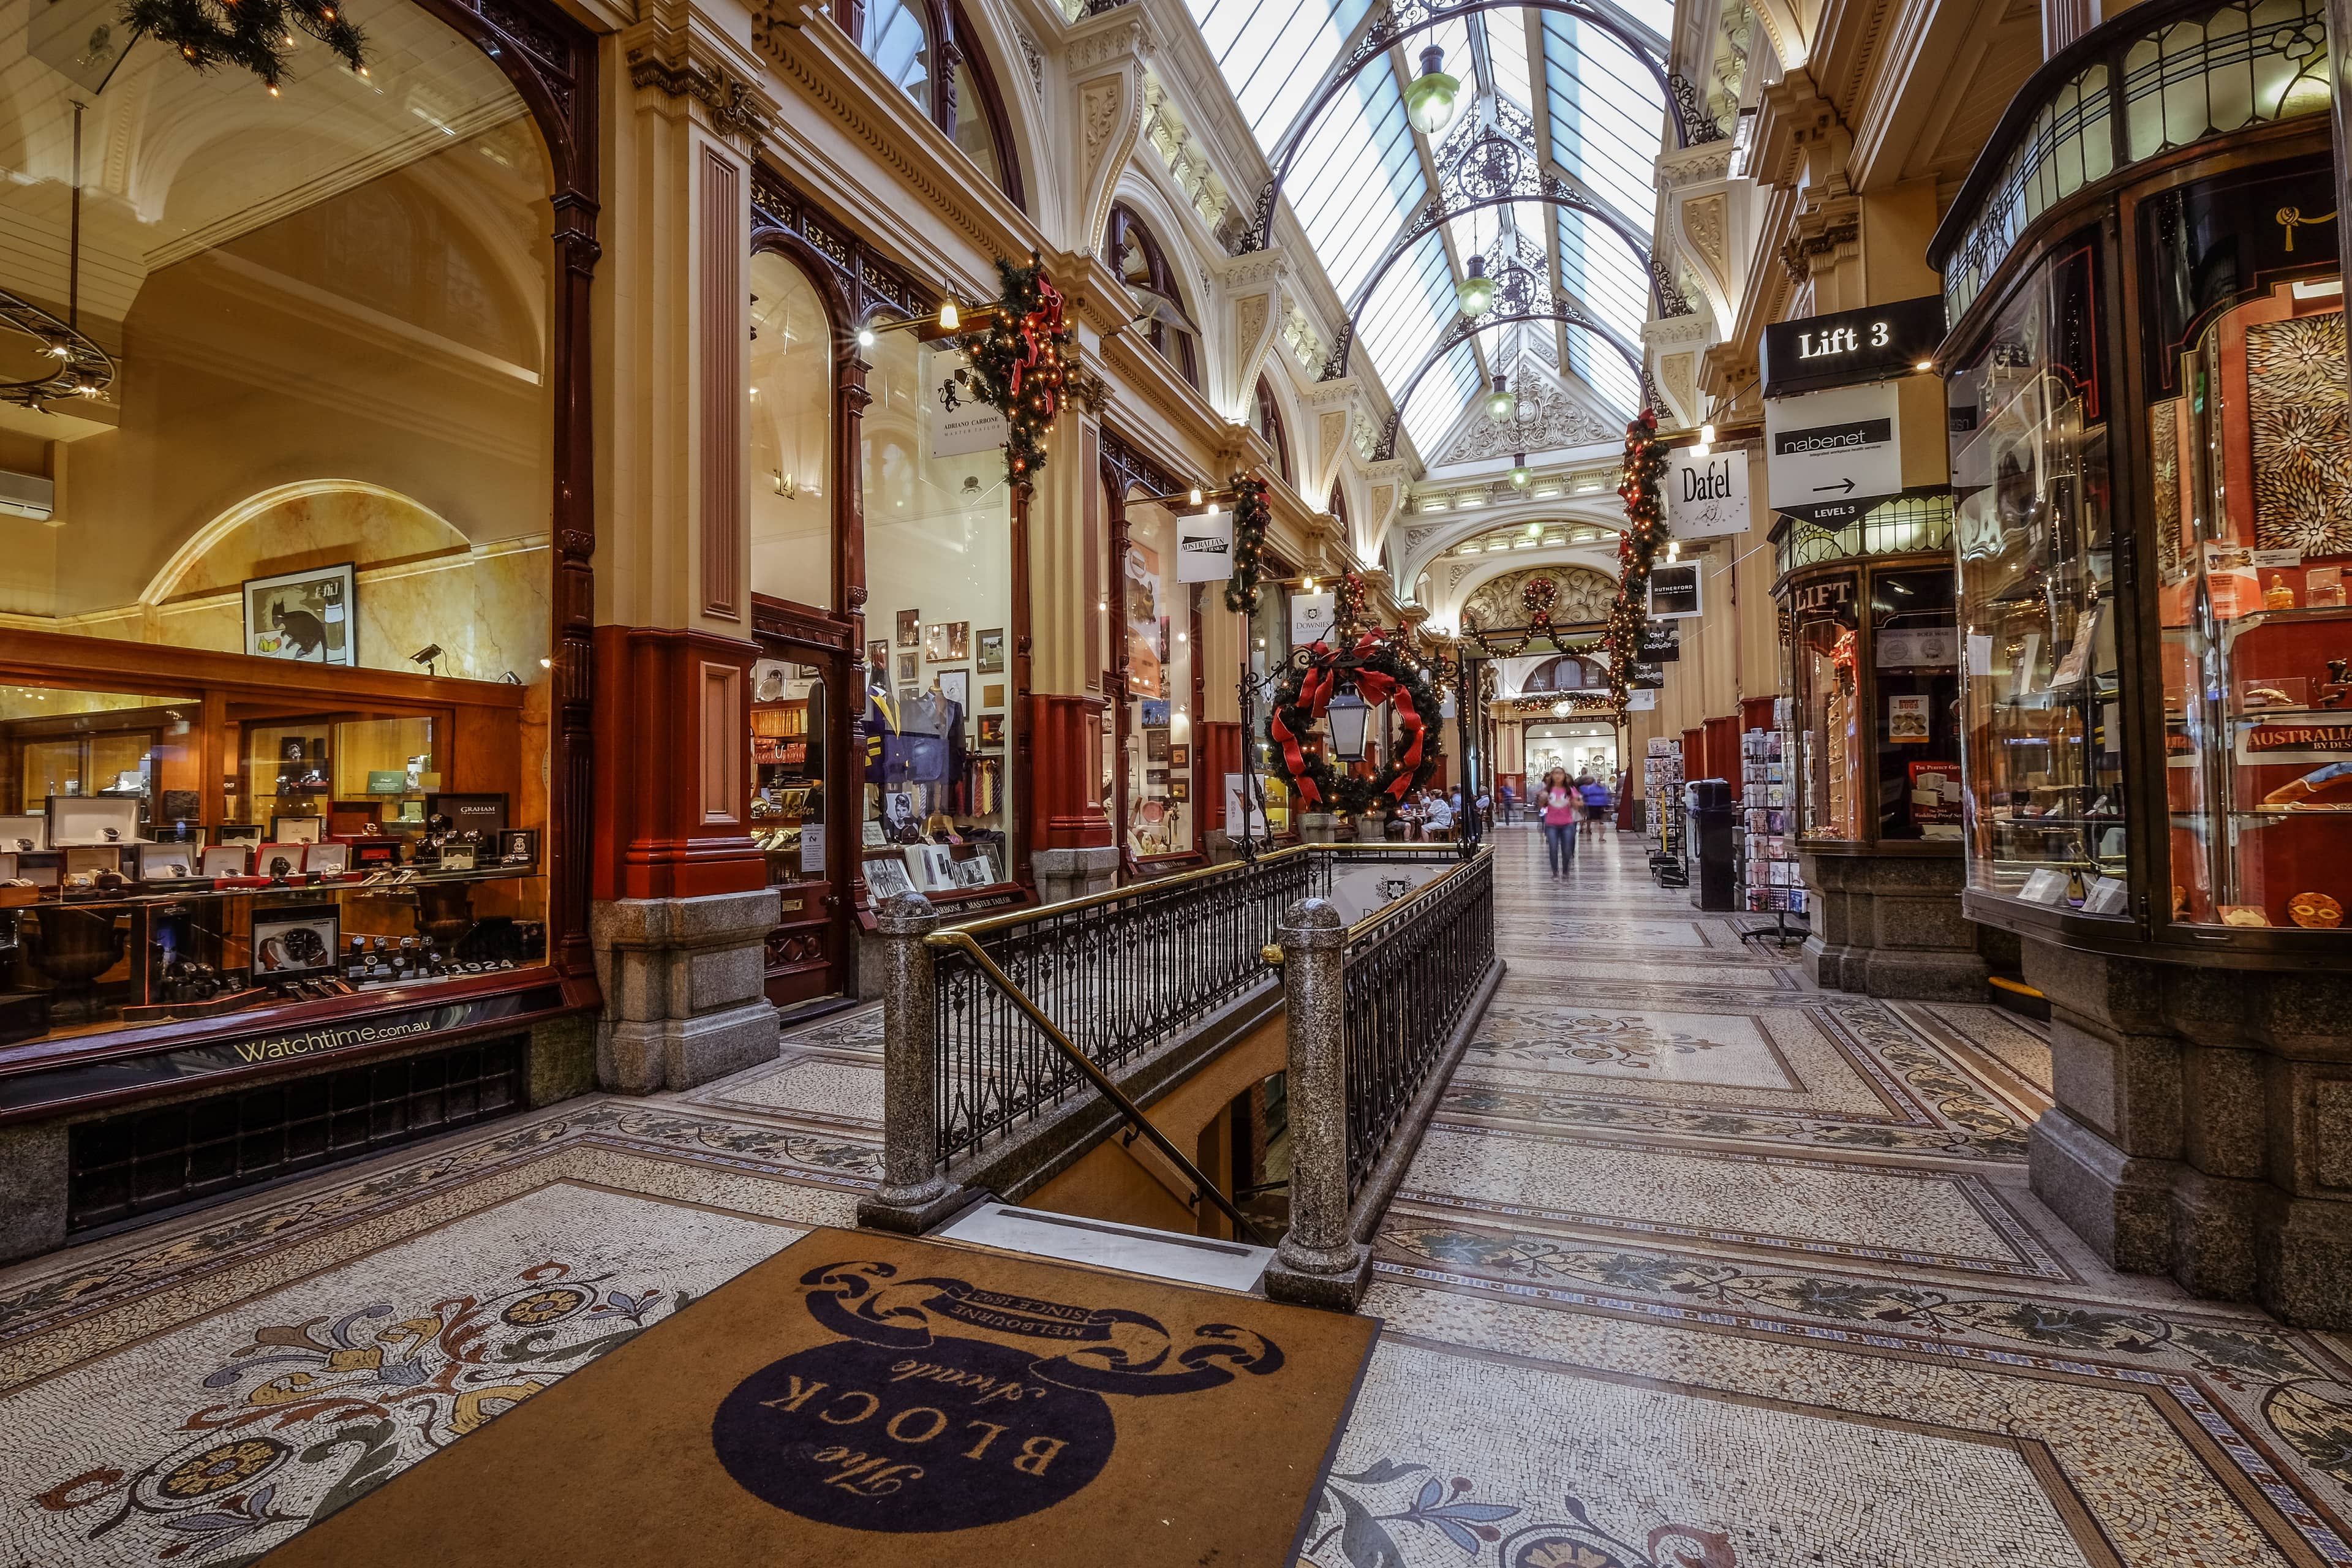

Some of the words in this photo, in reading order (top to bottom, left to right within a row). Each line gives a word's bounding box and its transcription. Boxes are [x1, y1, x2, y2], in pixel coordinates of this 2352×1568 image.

[1798, 328, 1858, 359] Lift
[1871, 322, 1889, 347] 3
[971, 417, 998, 425] CARBONE
[1785, 429, 1866, 452] nabenet
[1682, 458, 1732, 502] Dafel
[1815, 507, 1846, 518] LEVEL
[1181, 538, 1224, 551] AUSTRALIAN
[1795, 581, 1850, 611] LIFT
[967, 899, 991, 910] MASTER
[990, 896, 1012, 906] TAILOR
[451, 959, 514, 974] 1924
[234, 1020, 431, 1063] Watchtime.com.au
[950, 1304, 1086, 1338] MELBOURNE
[1017, 1300, 1089, 1319] SINCE
[760, 1375, 1069, 1477] BLOCK
[813, 1446, 924, 1496] The
